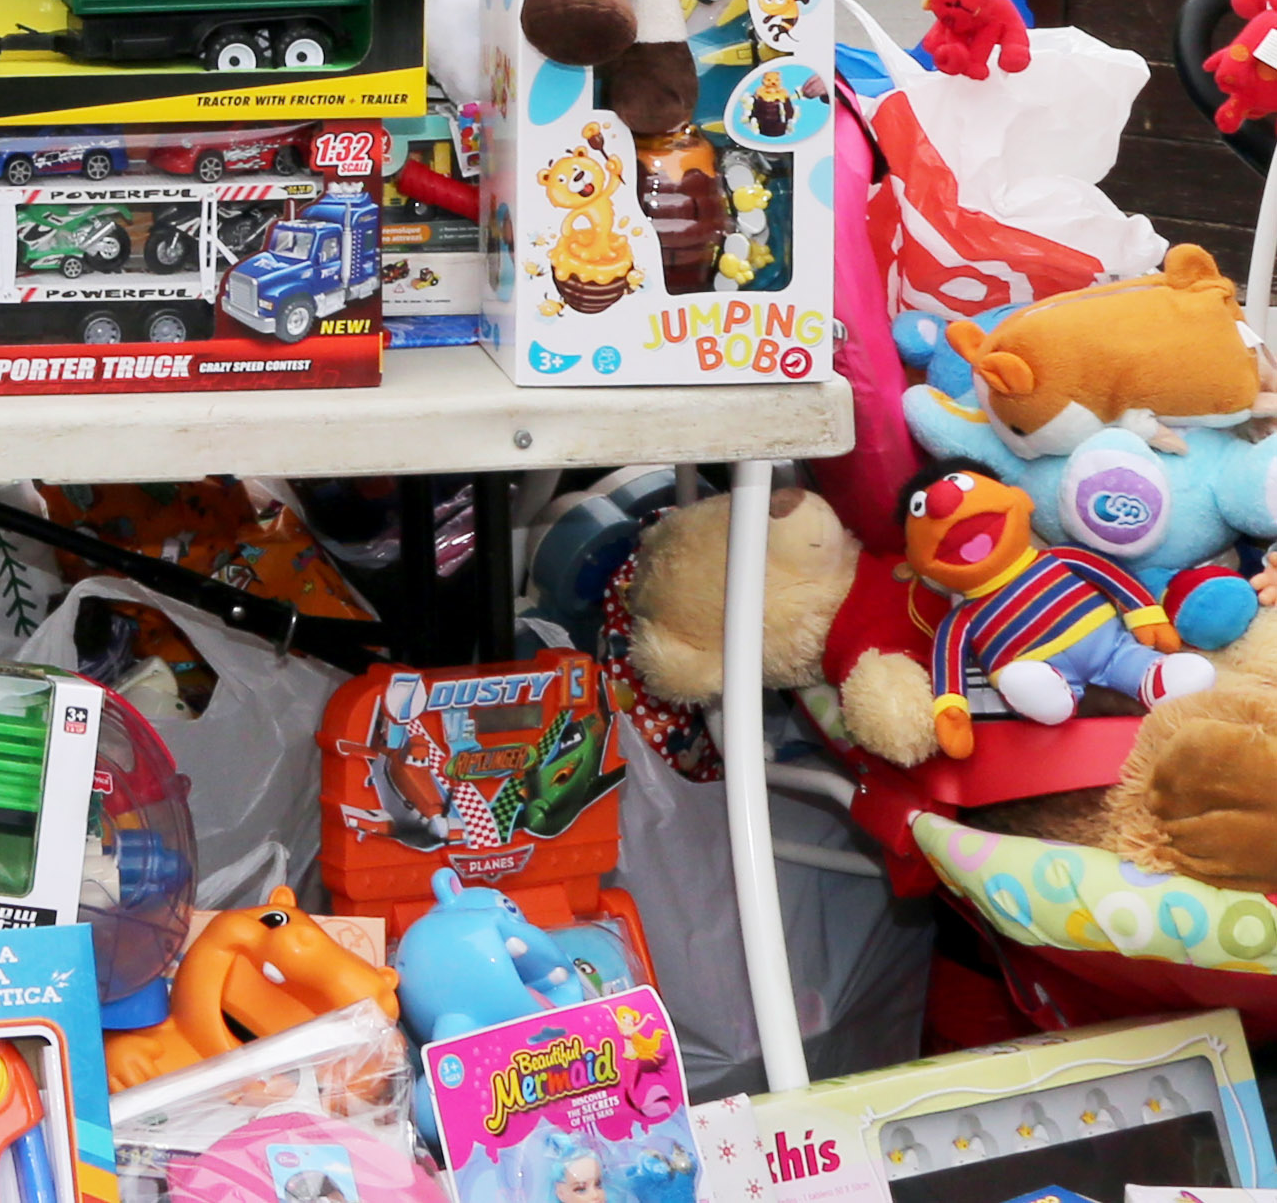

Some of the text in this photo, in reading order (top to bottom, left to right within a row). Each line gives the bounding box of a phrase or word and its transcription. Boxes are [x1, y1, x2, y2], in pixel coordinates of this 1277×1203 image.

[197, 94, 409, 107] TRACTOR WITH FRICTION TRAILER
[316, 133, 373, 163] 1:32
[340, 162, 368, 174] SCALE
[49, 187, 199, 200] POWERFUL
[43, 285, 191, 301] POWERFUL
[319, 319, 371, 336] NEW!
[642, 299, 825, 351] JUMPING
[101, 354, 191, 381] TRUCK
[198, 360, 233, 374] CRAZY
[235, 360, 266, 373] SPEED
[268, 359, 311, 373] CONTEST
[538, 351, 564, 371] 3+
[390, 674, 423, 722] 7
[428, 671, 556, 711] DUSTY
[66, 706, 86, 724] 3+
[469, 856, 516, 874] PLANES
[515, 1036, 582, 1075] Beautiful
[485, 1039, 618, 1130] Mermaid
[567, 1096, 620, 1119] THE SECRETS
[571, 1090, 608, 1107] DISCOVER
[570, 1108, 615, 1127] OF THE SEAS
